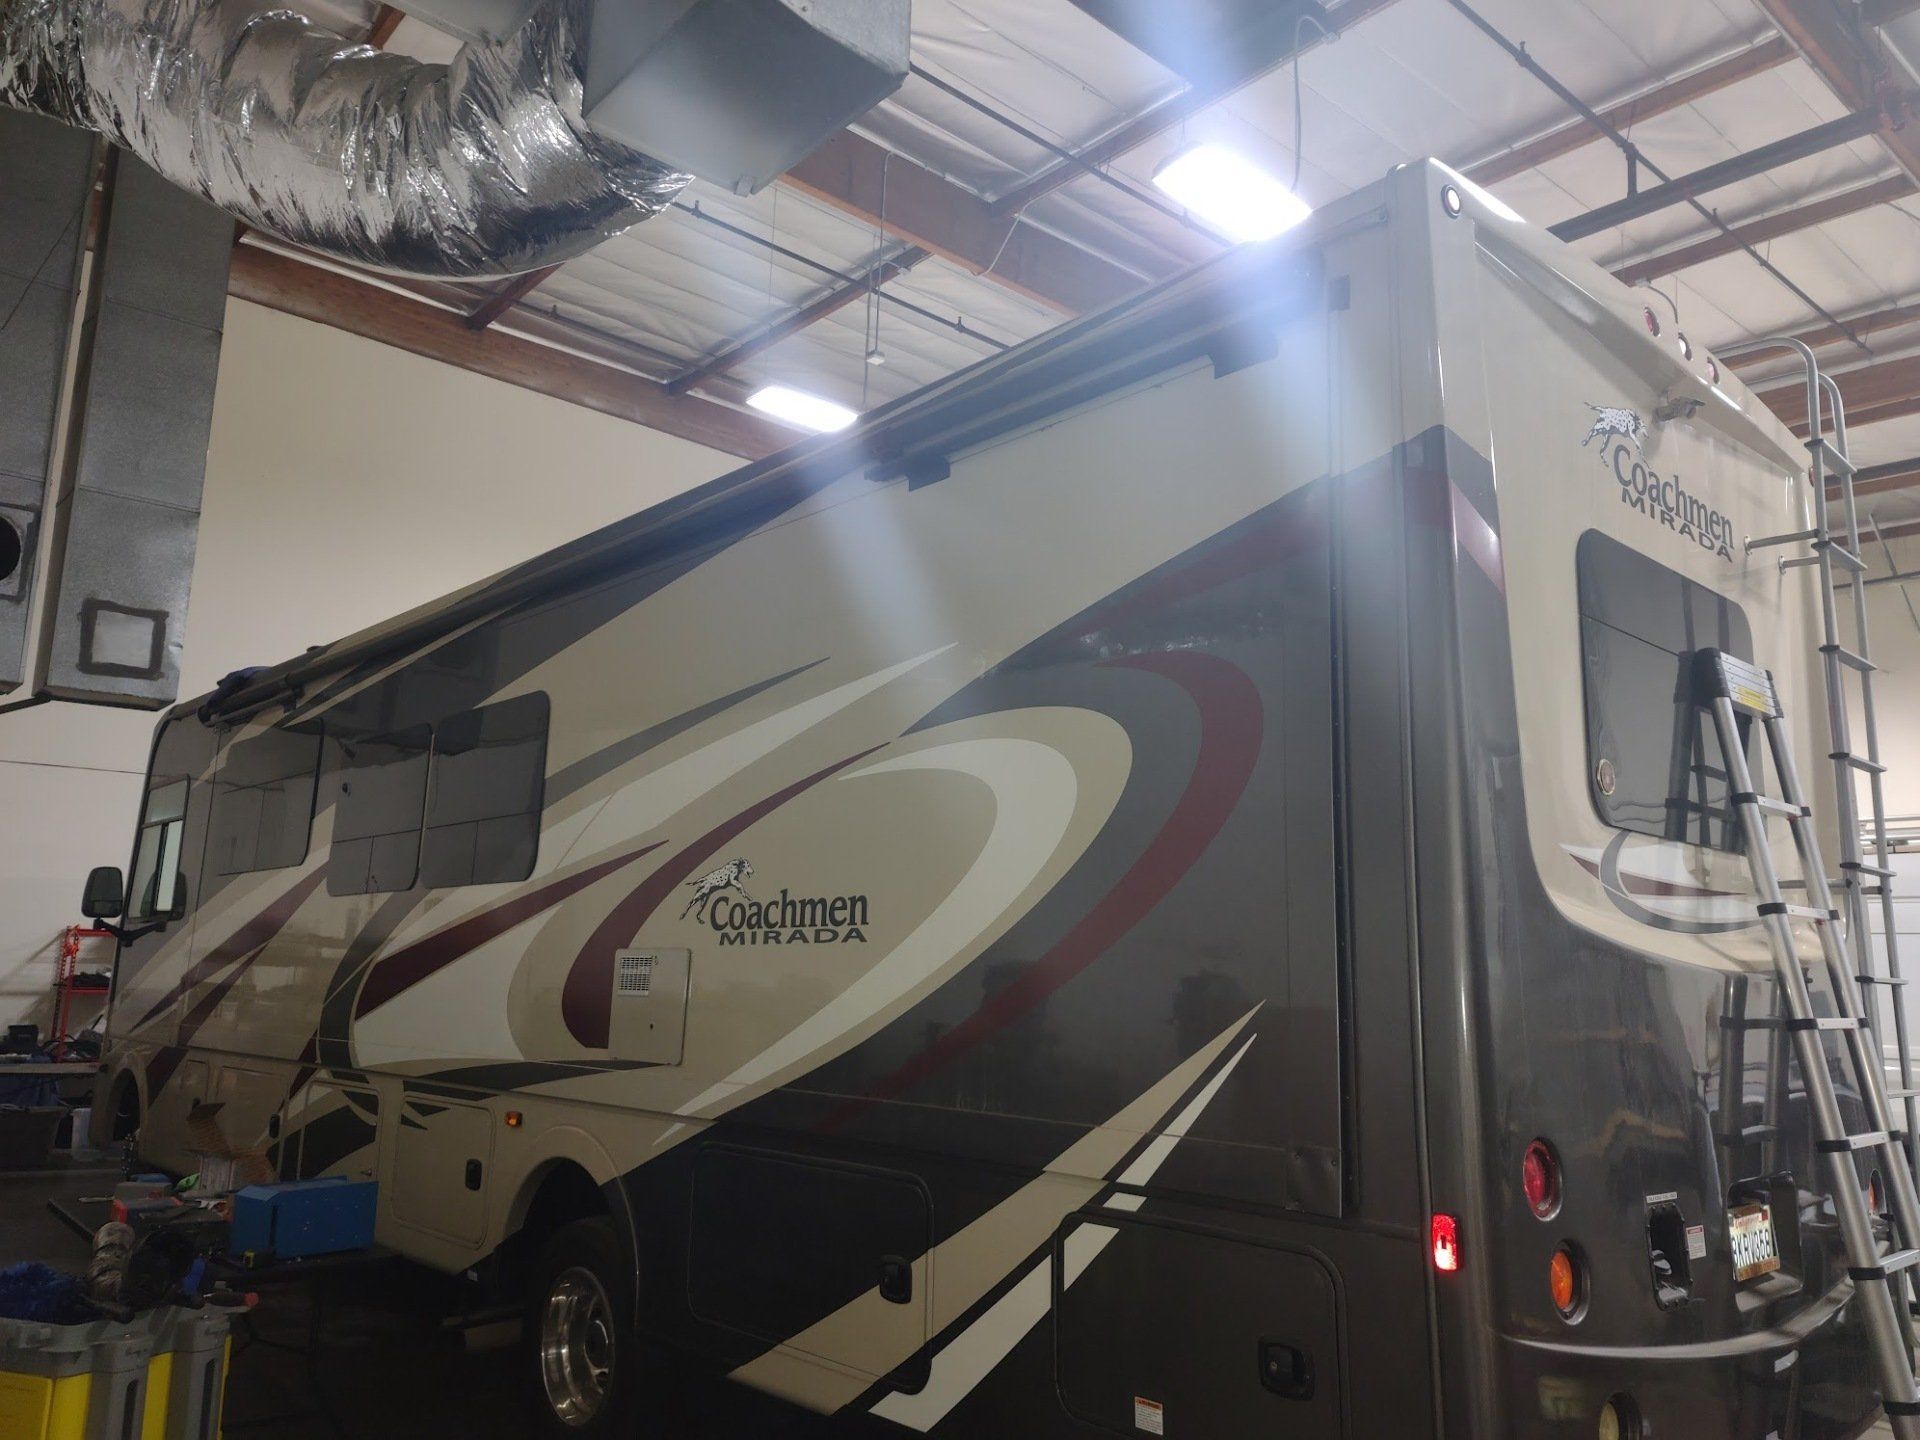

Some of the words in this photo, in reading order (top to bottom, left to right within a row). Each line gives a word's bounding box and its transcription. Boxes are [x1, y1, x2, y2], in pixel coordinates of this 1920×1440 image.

[1613, 444, 1735, 550] Coachmen
[1621, 487, 1734, 564] MIRADA
[710, 888, 869, 931] Coachmen
[719, 927, 868, 946] MIRADA
